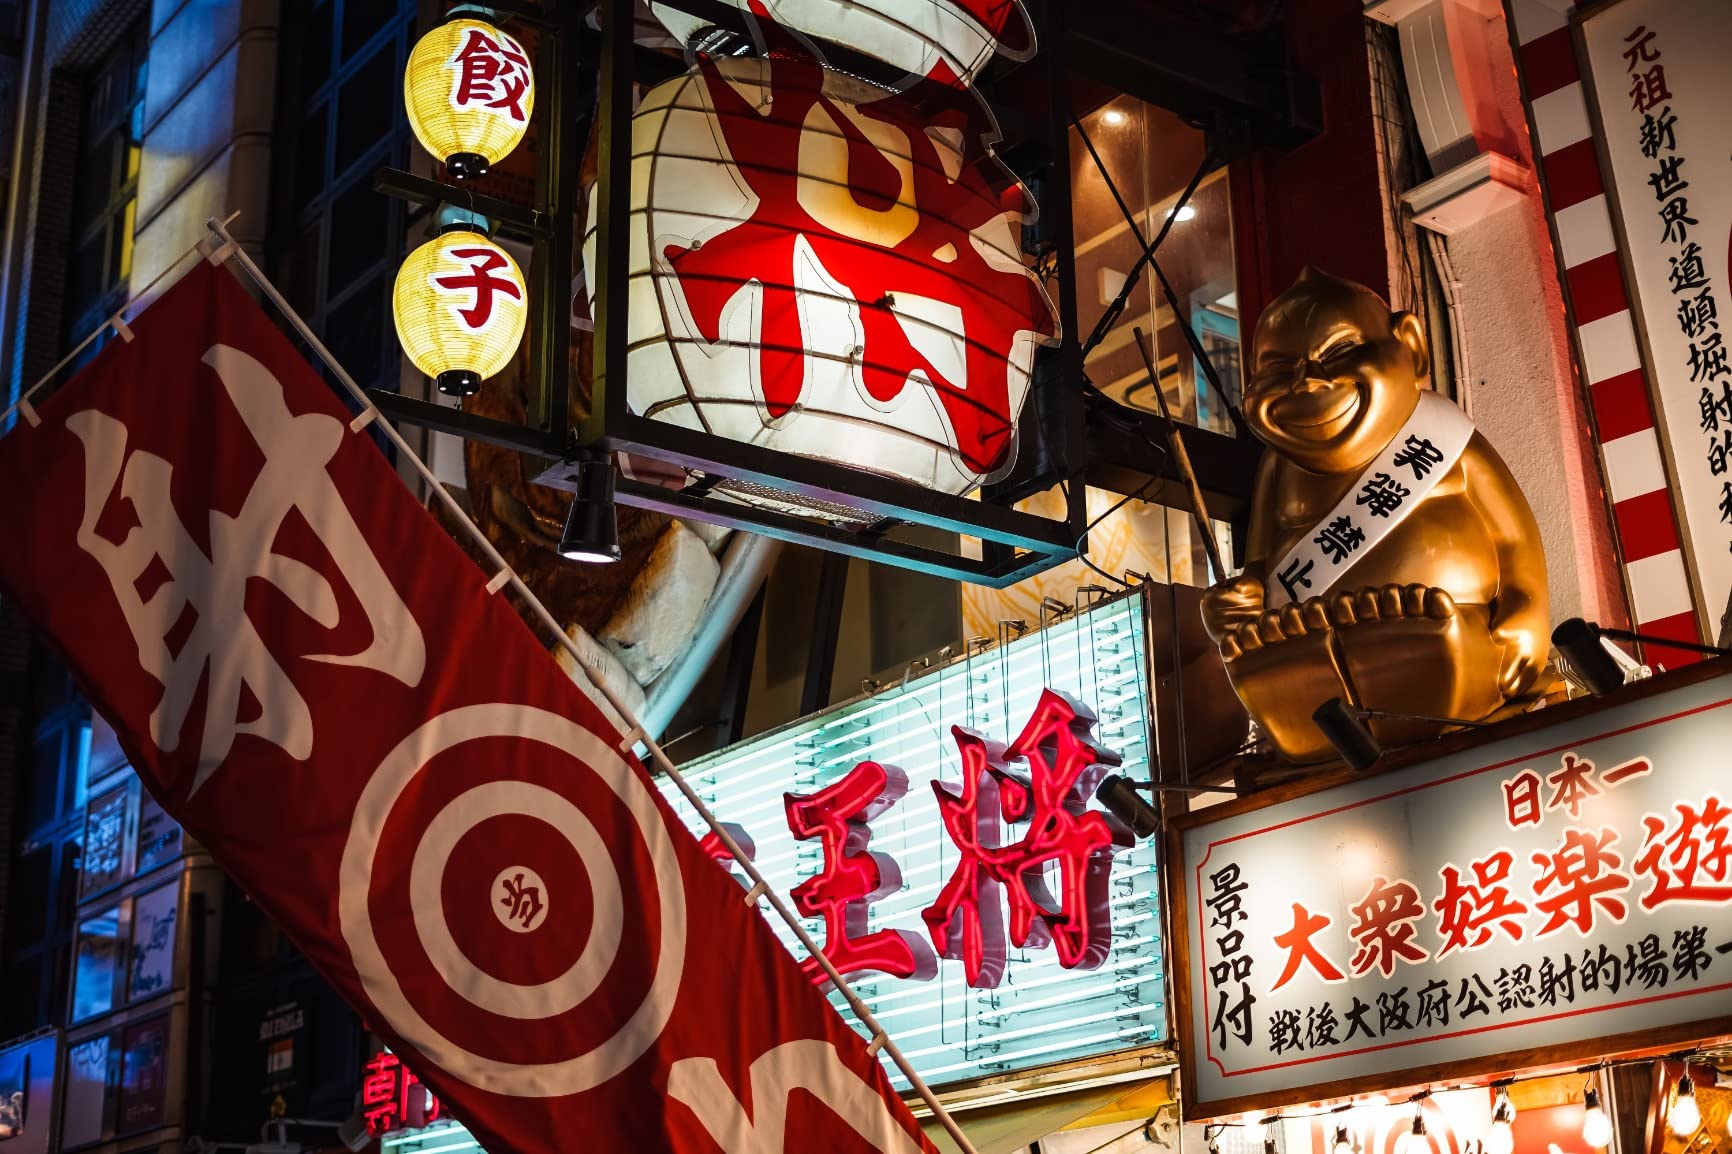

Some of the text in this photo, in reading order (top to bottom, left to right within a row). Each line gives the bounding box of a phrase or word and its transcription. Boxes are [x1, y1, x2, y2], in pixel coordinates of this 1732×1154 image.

[1622, 24, 1732, 523] 元祖新世界道頓堀射的
[42, 342, 427, 800] 射
[1277, 434, 1444, 602] 実弾禁止
[702, 687, 1127, 990] 王将
[1504, 754, 1652, 828] 日本一
[1206, 862, 1257, 1050] 景品付
[1266, 797, 1732, 993] 大衆娯楽遊
